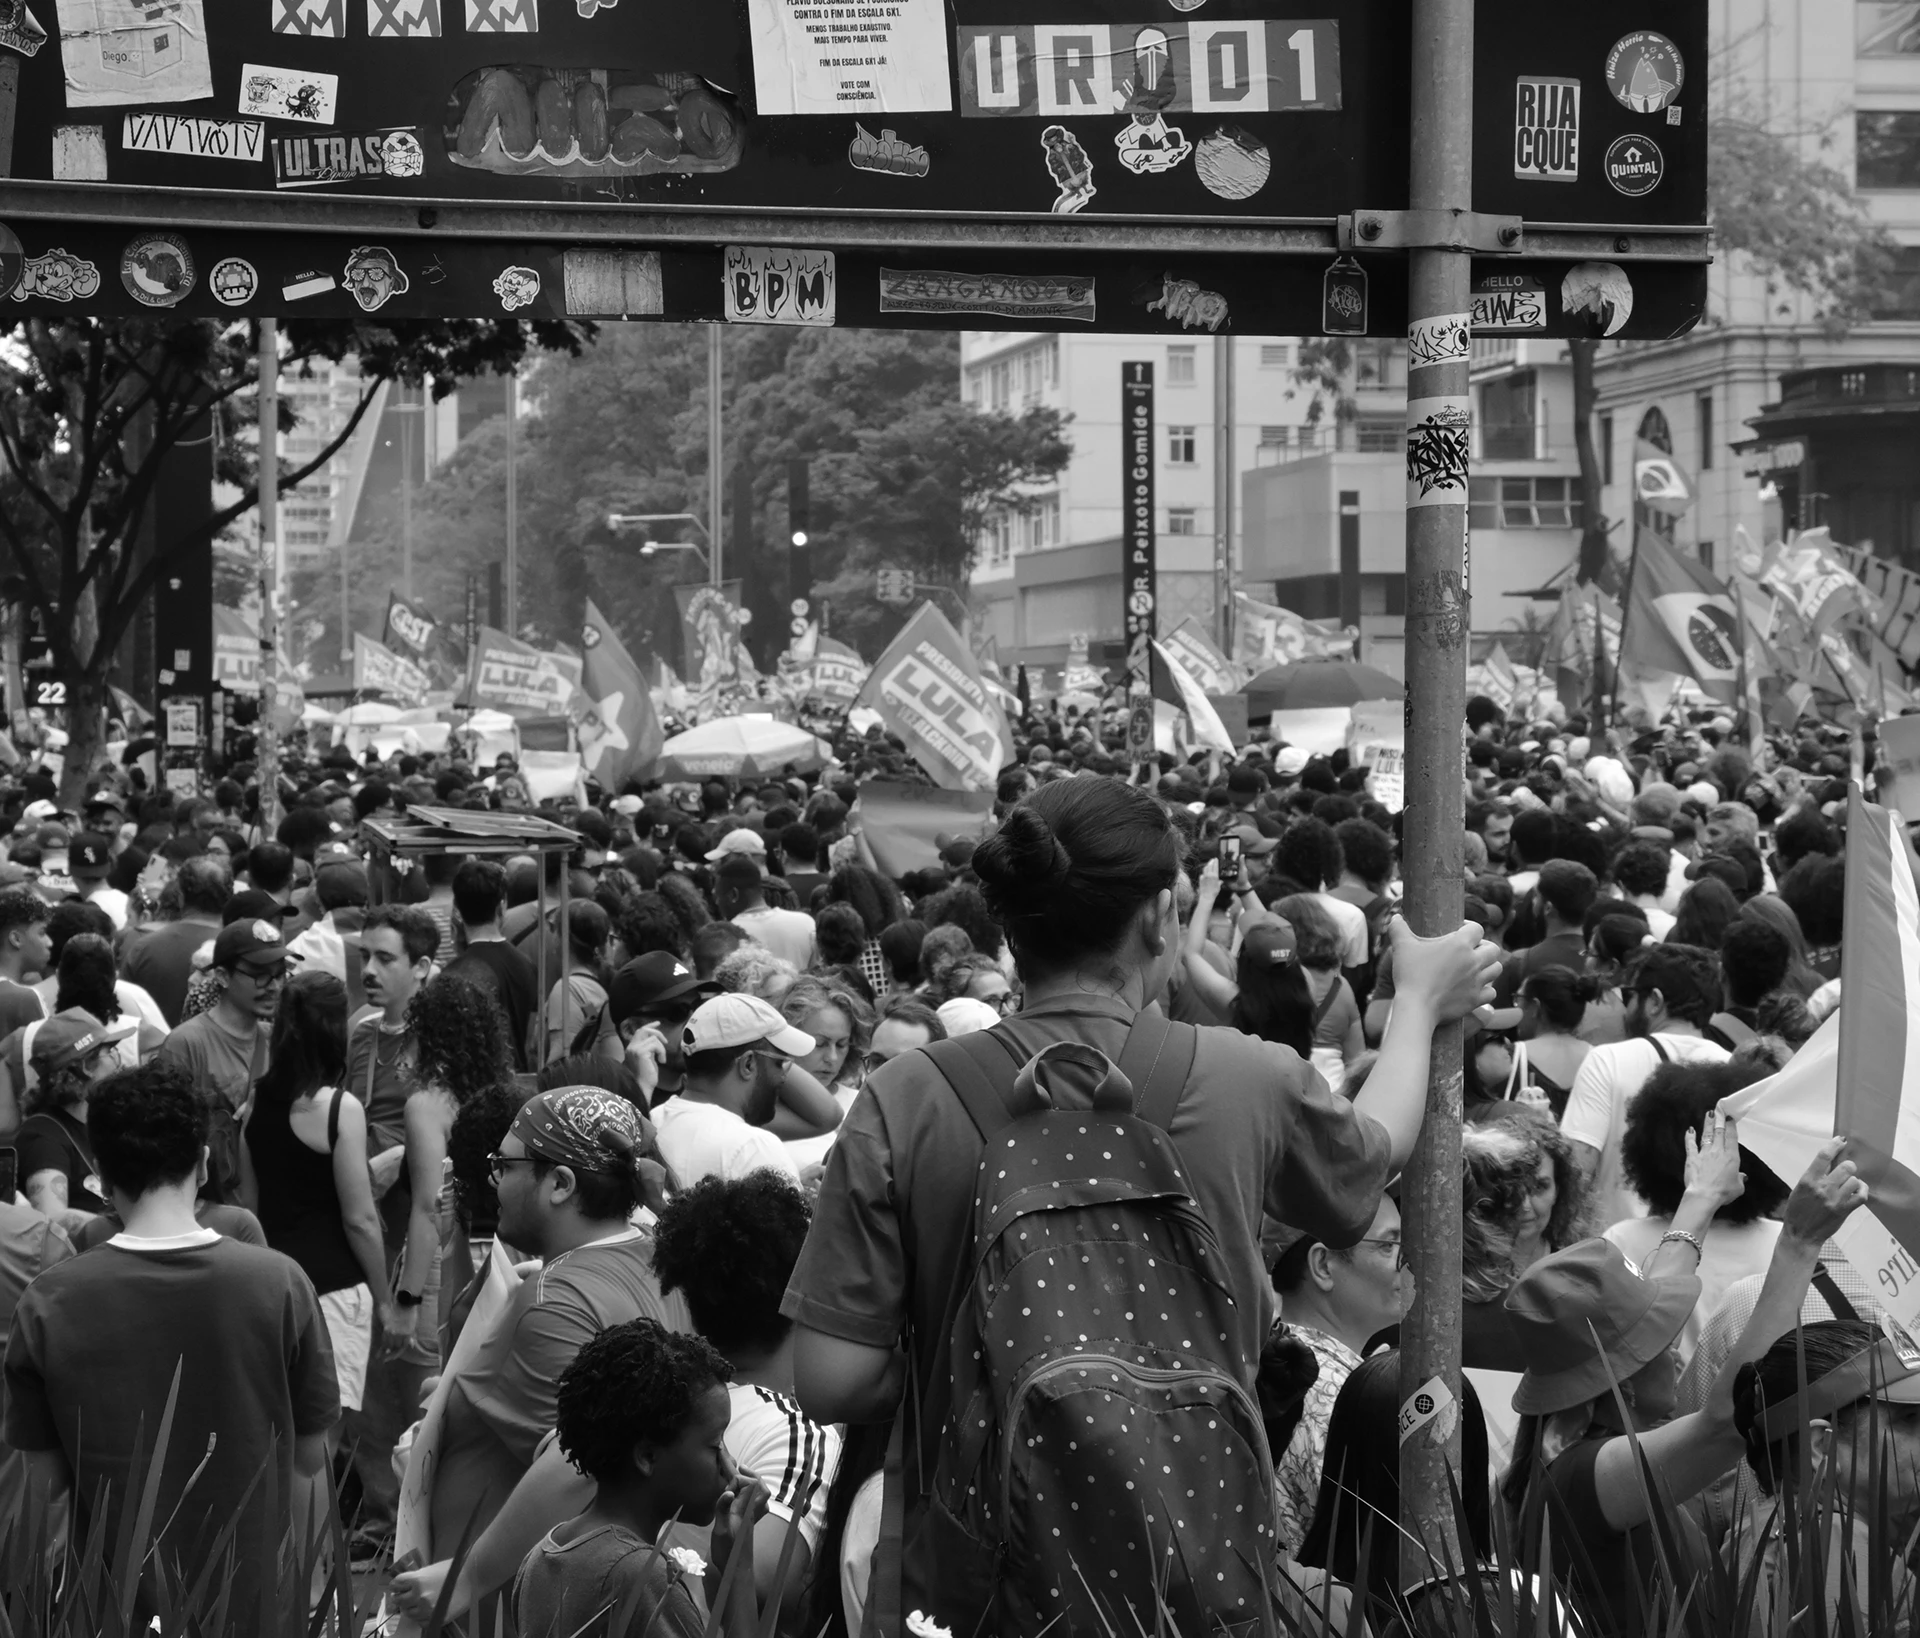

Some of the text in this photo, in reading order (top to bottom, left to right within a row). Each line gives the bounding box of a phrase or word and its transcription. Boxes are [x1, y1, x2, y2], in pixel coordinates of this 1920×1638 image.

[794, 7, 902, 20] CONTRA O FIM DA ESCALA 6X1.
[806, 23, 893, 33] MENOS TRABALHO EXAUSTIVO.
[814, 34, 889, 44] MAIS TEMPO PARA VIVER.
[103, 50, 131, 64] Diego.
[819, 55, 887, 67] FIM DA ESCALA 6X1 JÁ!
[836, 90, 877, 101] CONSCIÊNCIA.
[840, 80, 871, 90] VOTE COM
[1518, 84, 1577, 129] RIJA
[284, 136, 383, 177] ULTRAS
[1517, 127, 1577, 175] CQUE
[1611, 161, 1659, 179] QUINTAL
[295, 270, 316, 281] HELLO
[731, 260, 830, 318] BPM
[1132, 405, 1148, 481] Gomide
[1133, 484, 1149, 565] Peixoto
[482, 666, 559, 694] LULA
[37, 681, 67, 705] 22
[892, 662, 997, 764] LULA
[913, 719, 970, 772] ALCKMIN
